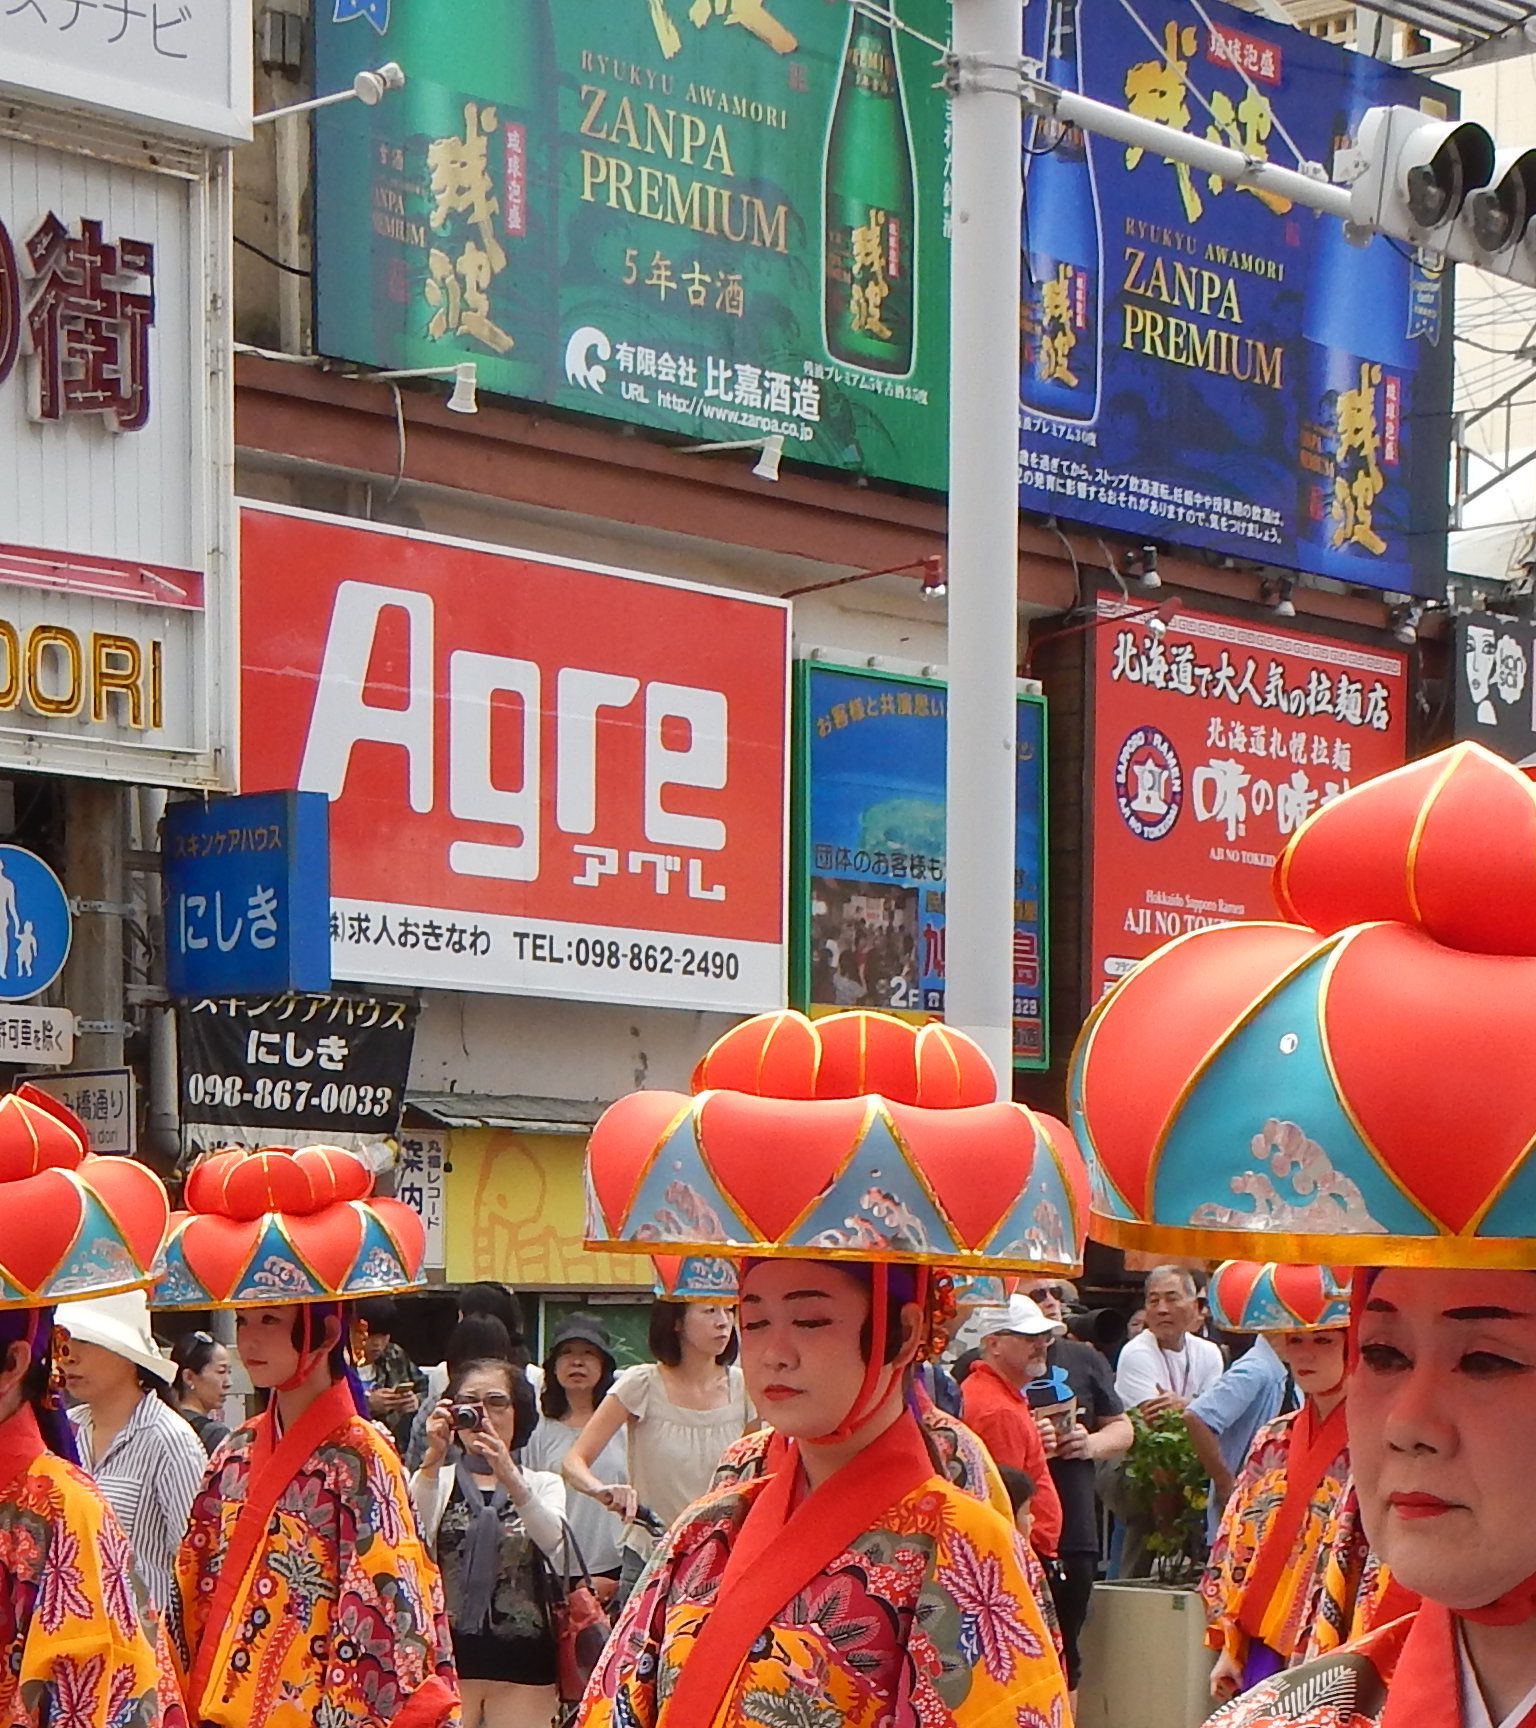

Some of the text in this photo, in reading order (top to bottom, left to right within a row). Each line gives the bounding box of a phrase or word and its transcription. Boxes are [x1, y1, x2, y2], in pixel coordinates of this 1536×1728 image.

[580, 49, 788, 130] RYUKYU AWAMORI
[580, 84, 735, 177] ZANPA
[579, 149, 789, 254] PREMIUM
[1125, 217, 1285, 282] RYUKYU AWAMORI
[623, 248, 745, 318] 5年古酒
[1124, 247, 1242, 323] ZANPA
[1124, 305, 1283, 389] PREMIUM
[615, 342, 821, 422] 有限会社 比嘉酒造
[621, 380, 814, 441] URL http://www.zanpa.co.jp
[298, 579, 728, 882] Agre
[175, 825, 282, 857] スキンケアハウス
[573, 844, 726, 901] アグレ
[815, 843, 944, 882] 団体のお客様も
[180, 884, 279, 954] にしき
[1124, 907, 1152, 933] AJI
[1156, 911, 1180, 936] NO
[514, 931, 739, 982] TEL:098-862-2490
[890, 975, 919, 1008] 2F
[247, 1029, 349, 1071] にしき
[188, 1073, 393, 1117] 098-867-0033
